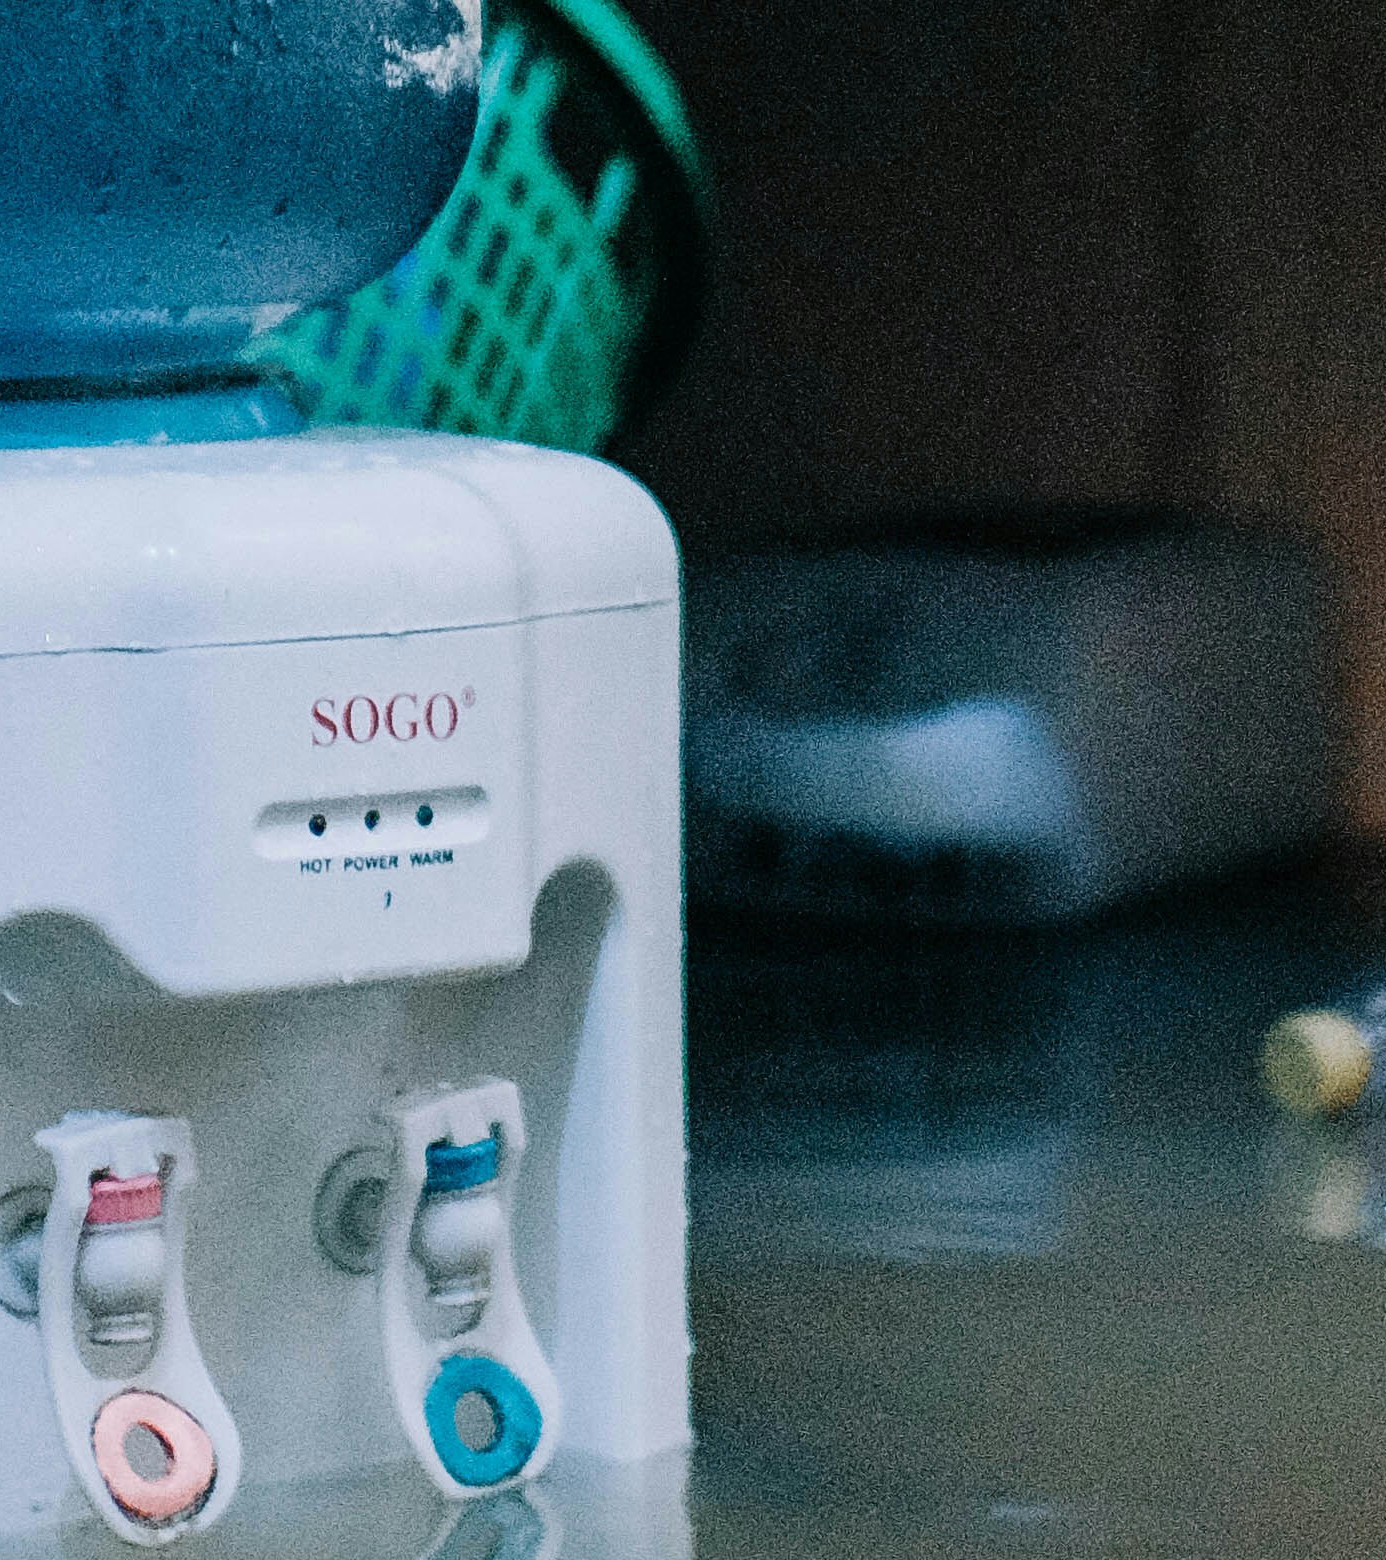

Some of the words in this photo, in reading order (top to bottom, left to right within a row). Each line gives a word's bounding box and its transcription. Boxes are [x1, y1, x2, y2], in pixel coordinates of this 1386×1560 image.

[310, 691, 460, 748] SOGO
[299, 857, 332, 874] HOT
[343, 854, 399, 871] POWER
[409, 848, 455, 867] WARM
